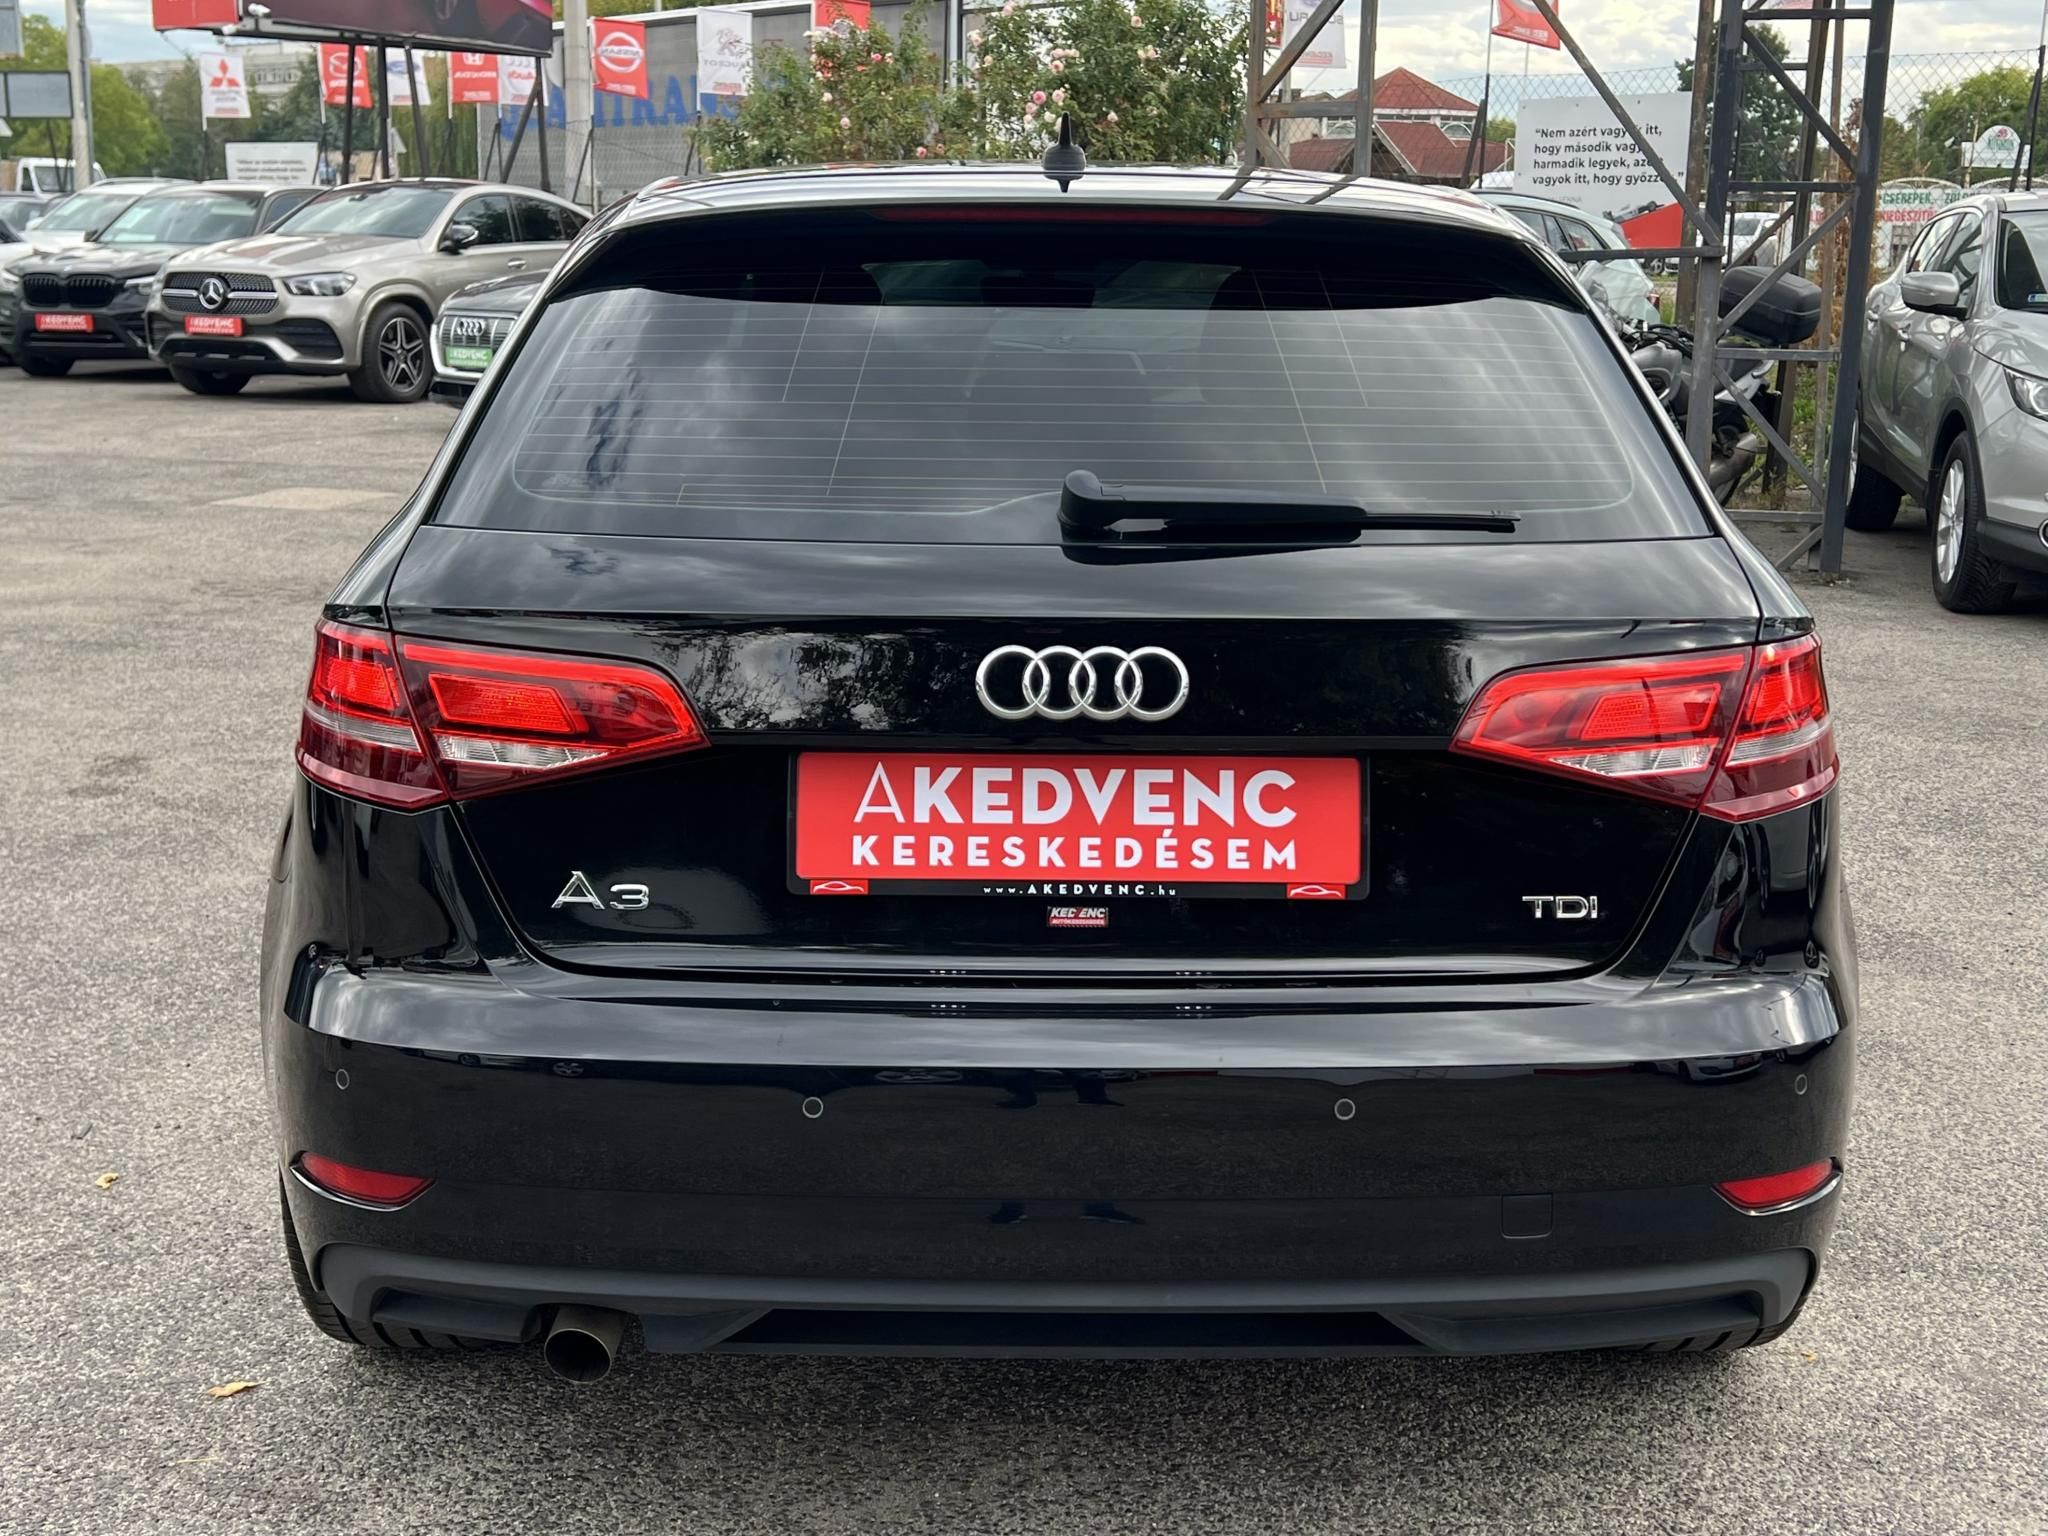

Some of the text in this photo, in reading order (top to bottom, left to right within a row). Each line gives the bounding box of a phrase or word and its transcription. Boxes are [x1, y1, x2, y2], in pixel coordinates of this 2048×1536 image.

[1569, 127, 1597, 138] azért
[1645, 123, 1662, 136] itt,
[1534, 143, 1561, 155] hogy
[1564, 141, 1611, 153] második
[1533, 157, 1584, 169] harmadik
[1588, 157, 1630, 170] legyek,
[1533, 174, 1571, 186] vagyok
[1574, 172, 1590, 184] itt,
[1593, 172, 1622, 186] hogy
[853, 761, 1297, 828] AKEDVENC
[851, 829, 1297, 871] KERESKEDÉSEM
[551, 870, 650, 910] A3
[982, 883, 1177, 897] www.AKEDVENC.hu
[1522, 895, 1598, 919] TDI
